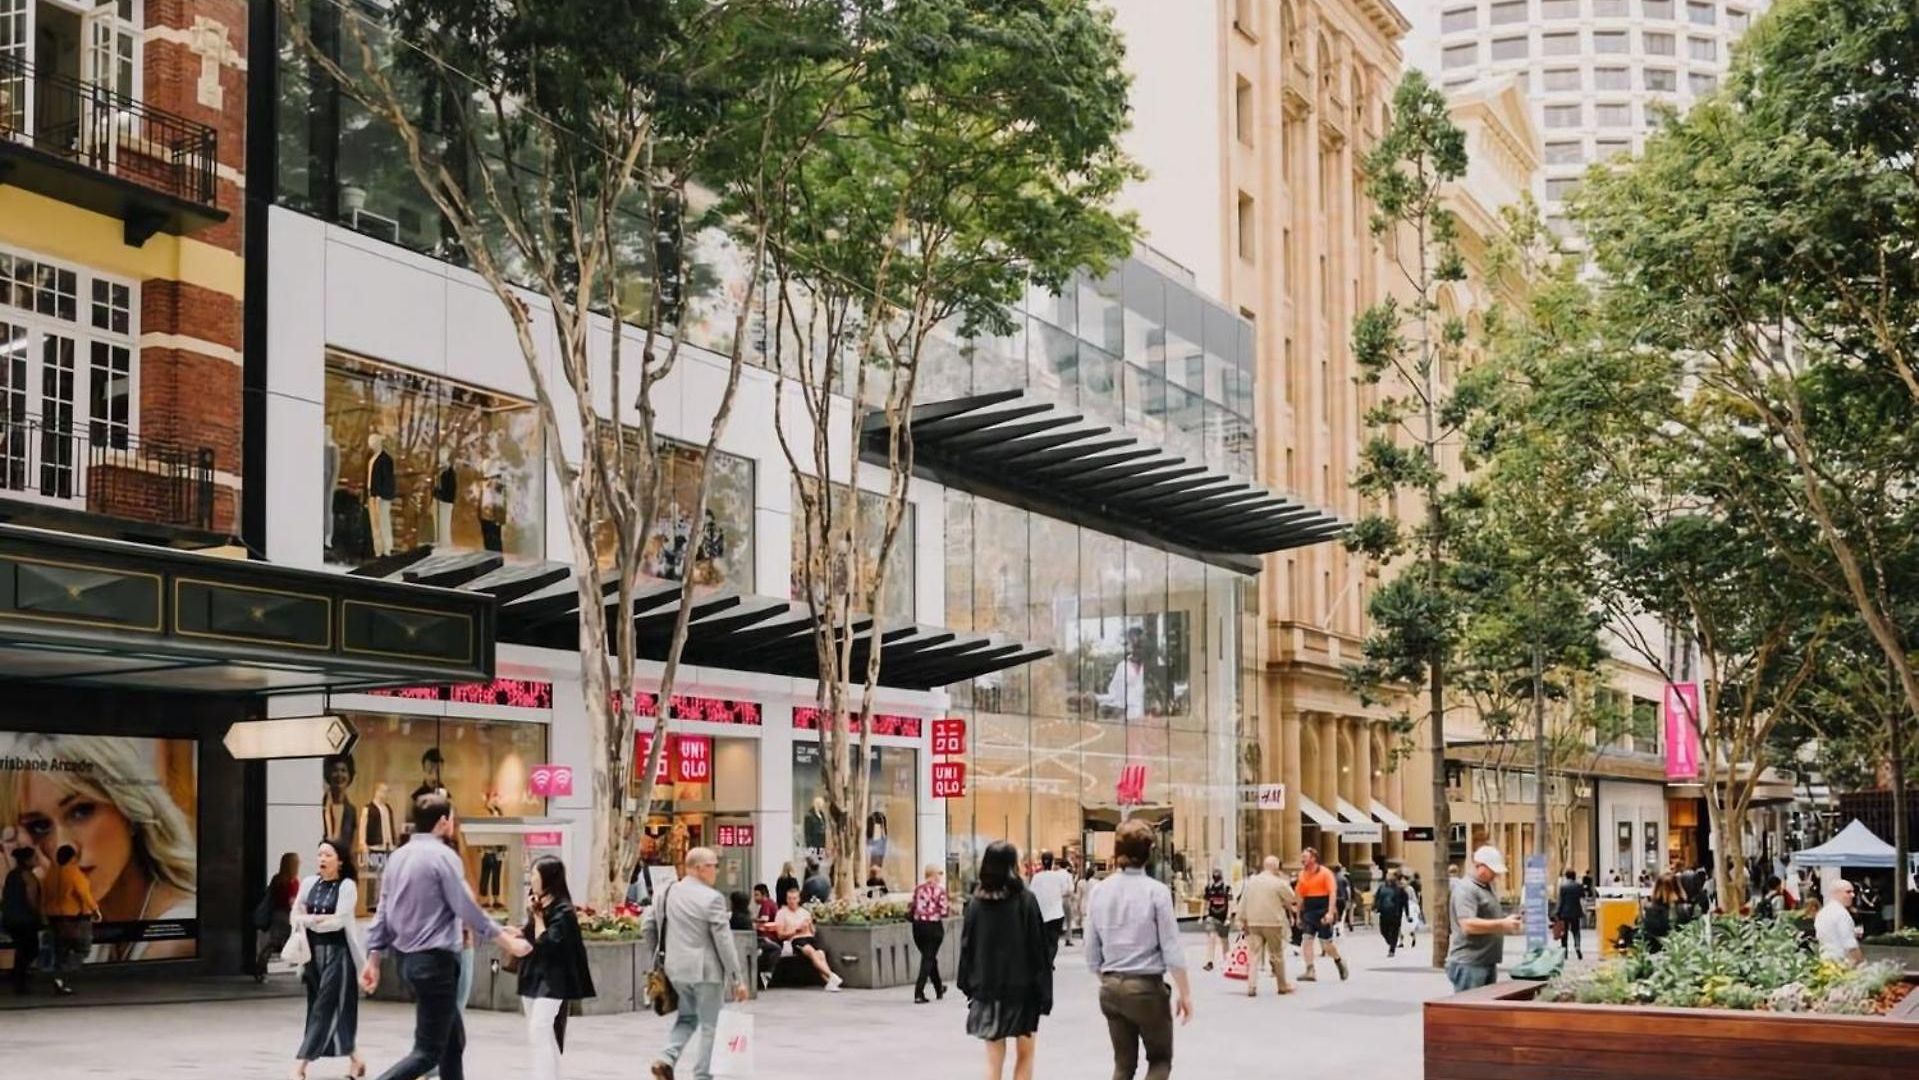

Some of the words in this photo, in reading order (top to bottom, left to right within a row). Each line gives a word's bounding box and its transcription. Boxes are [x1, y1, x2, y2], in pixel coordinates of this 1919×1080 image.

[936, 724, 959, 736] ユニ
[681, 741, 705, 759] UNI
[936, 738, 959, 752] クロ
[681, 761, 707, 779] QLO
[935, 767, 958, 779] UNI
[935, 781, 959, 795] QLO
